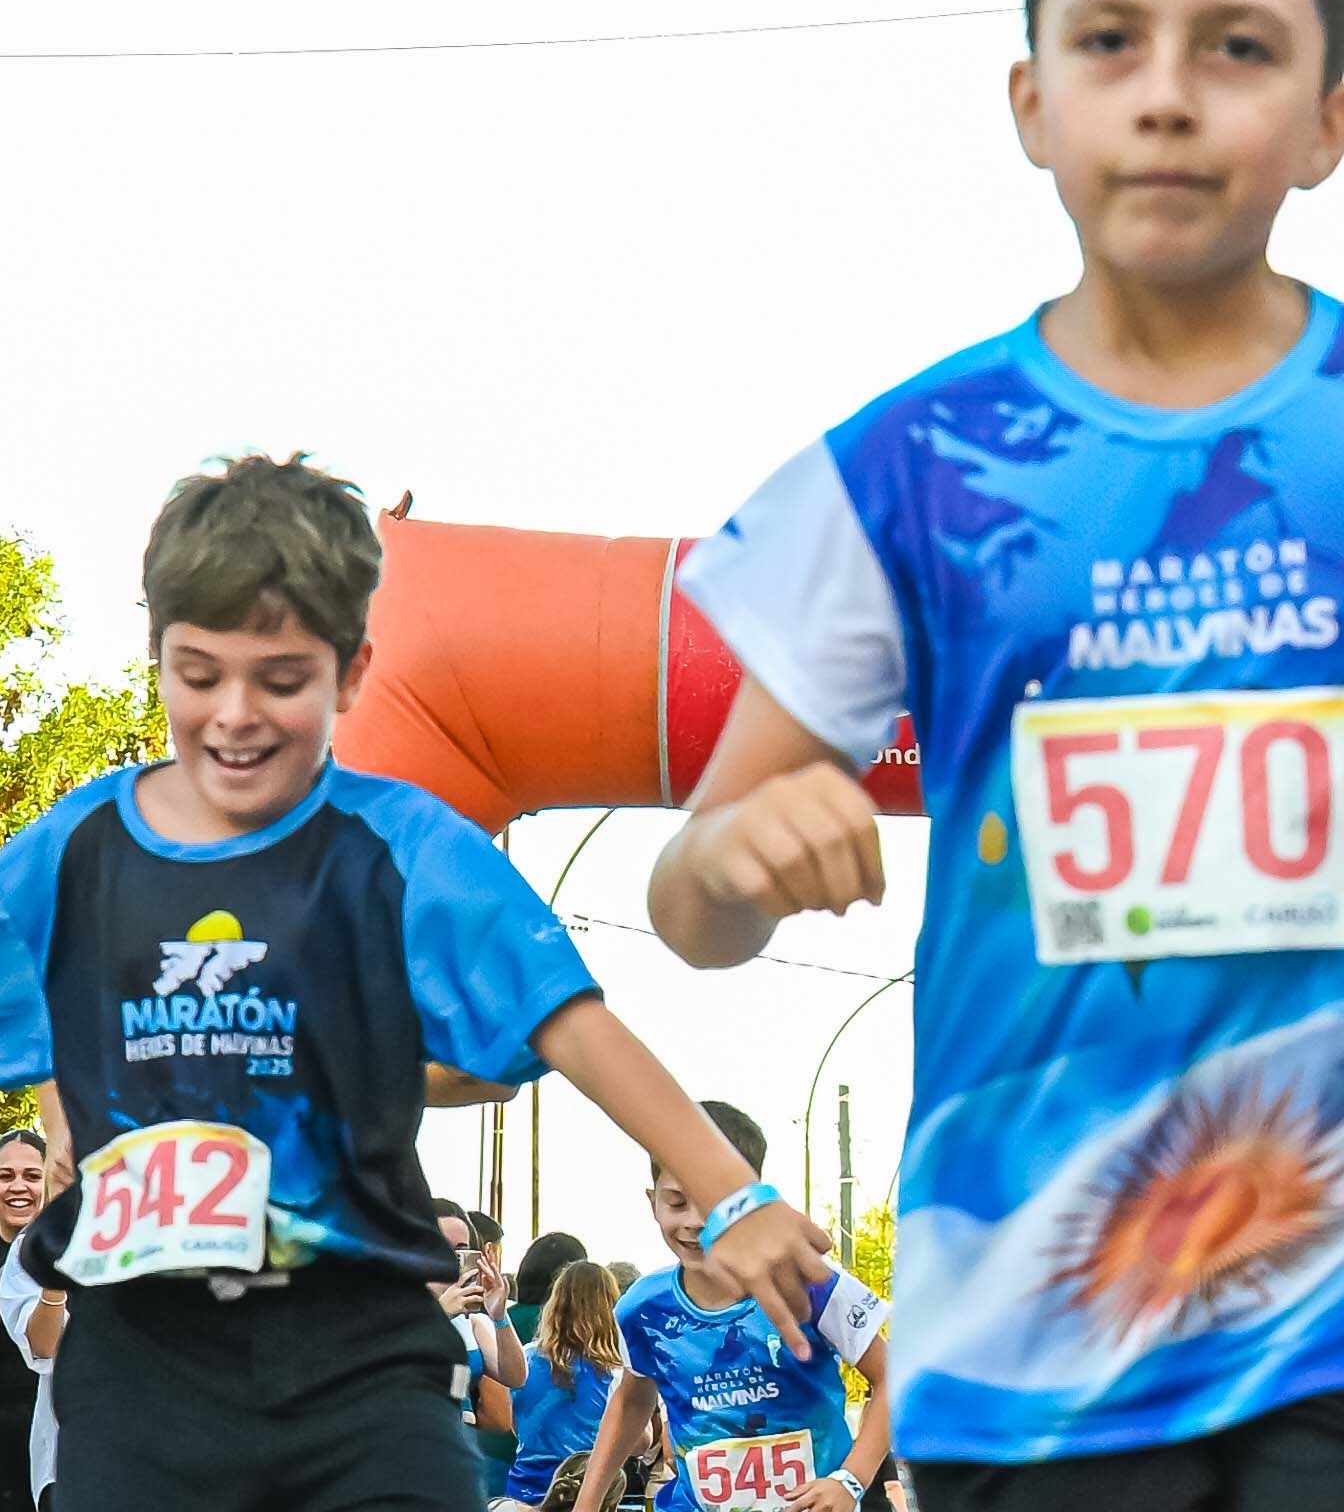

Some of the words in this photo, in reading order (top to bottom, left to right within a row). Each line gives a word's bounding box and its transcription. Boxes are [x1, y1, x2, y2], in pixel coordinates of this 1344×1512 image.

[1069, 595, 1340, 670] MALVINAS
[1042, 718, 1332, 893] 570
[121, 987, 298, 1038] MARATÓN
[90, 1140, 249, 1252] 542
[692, 1382, 780, 1411] MALVINAS
[698, 1441, 806, 1503] 545
